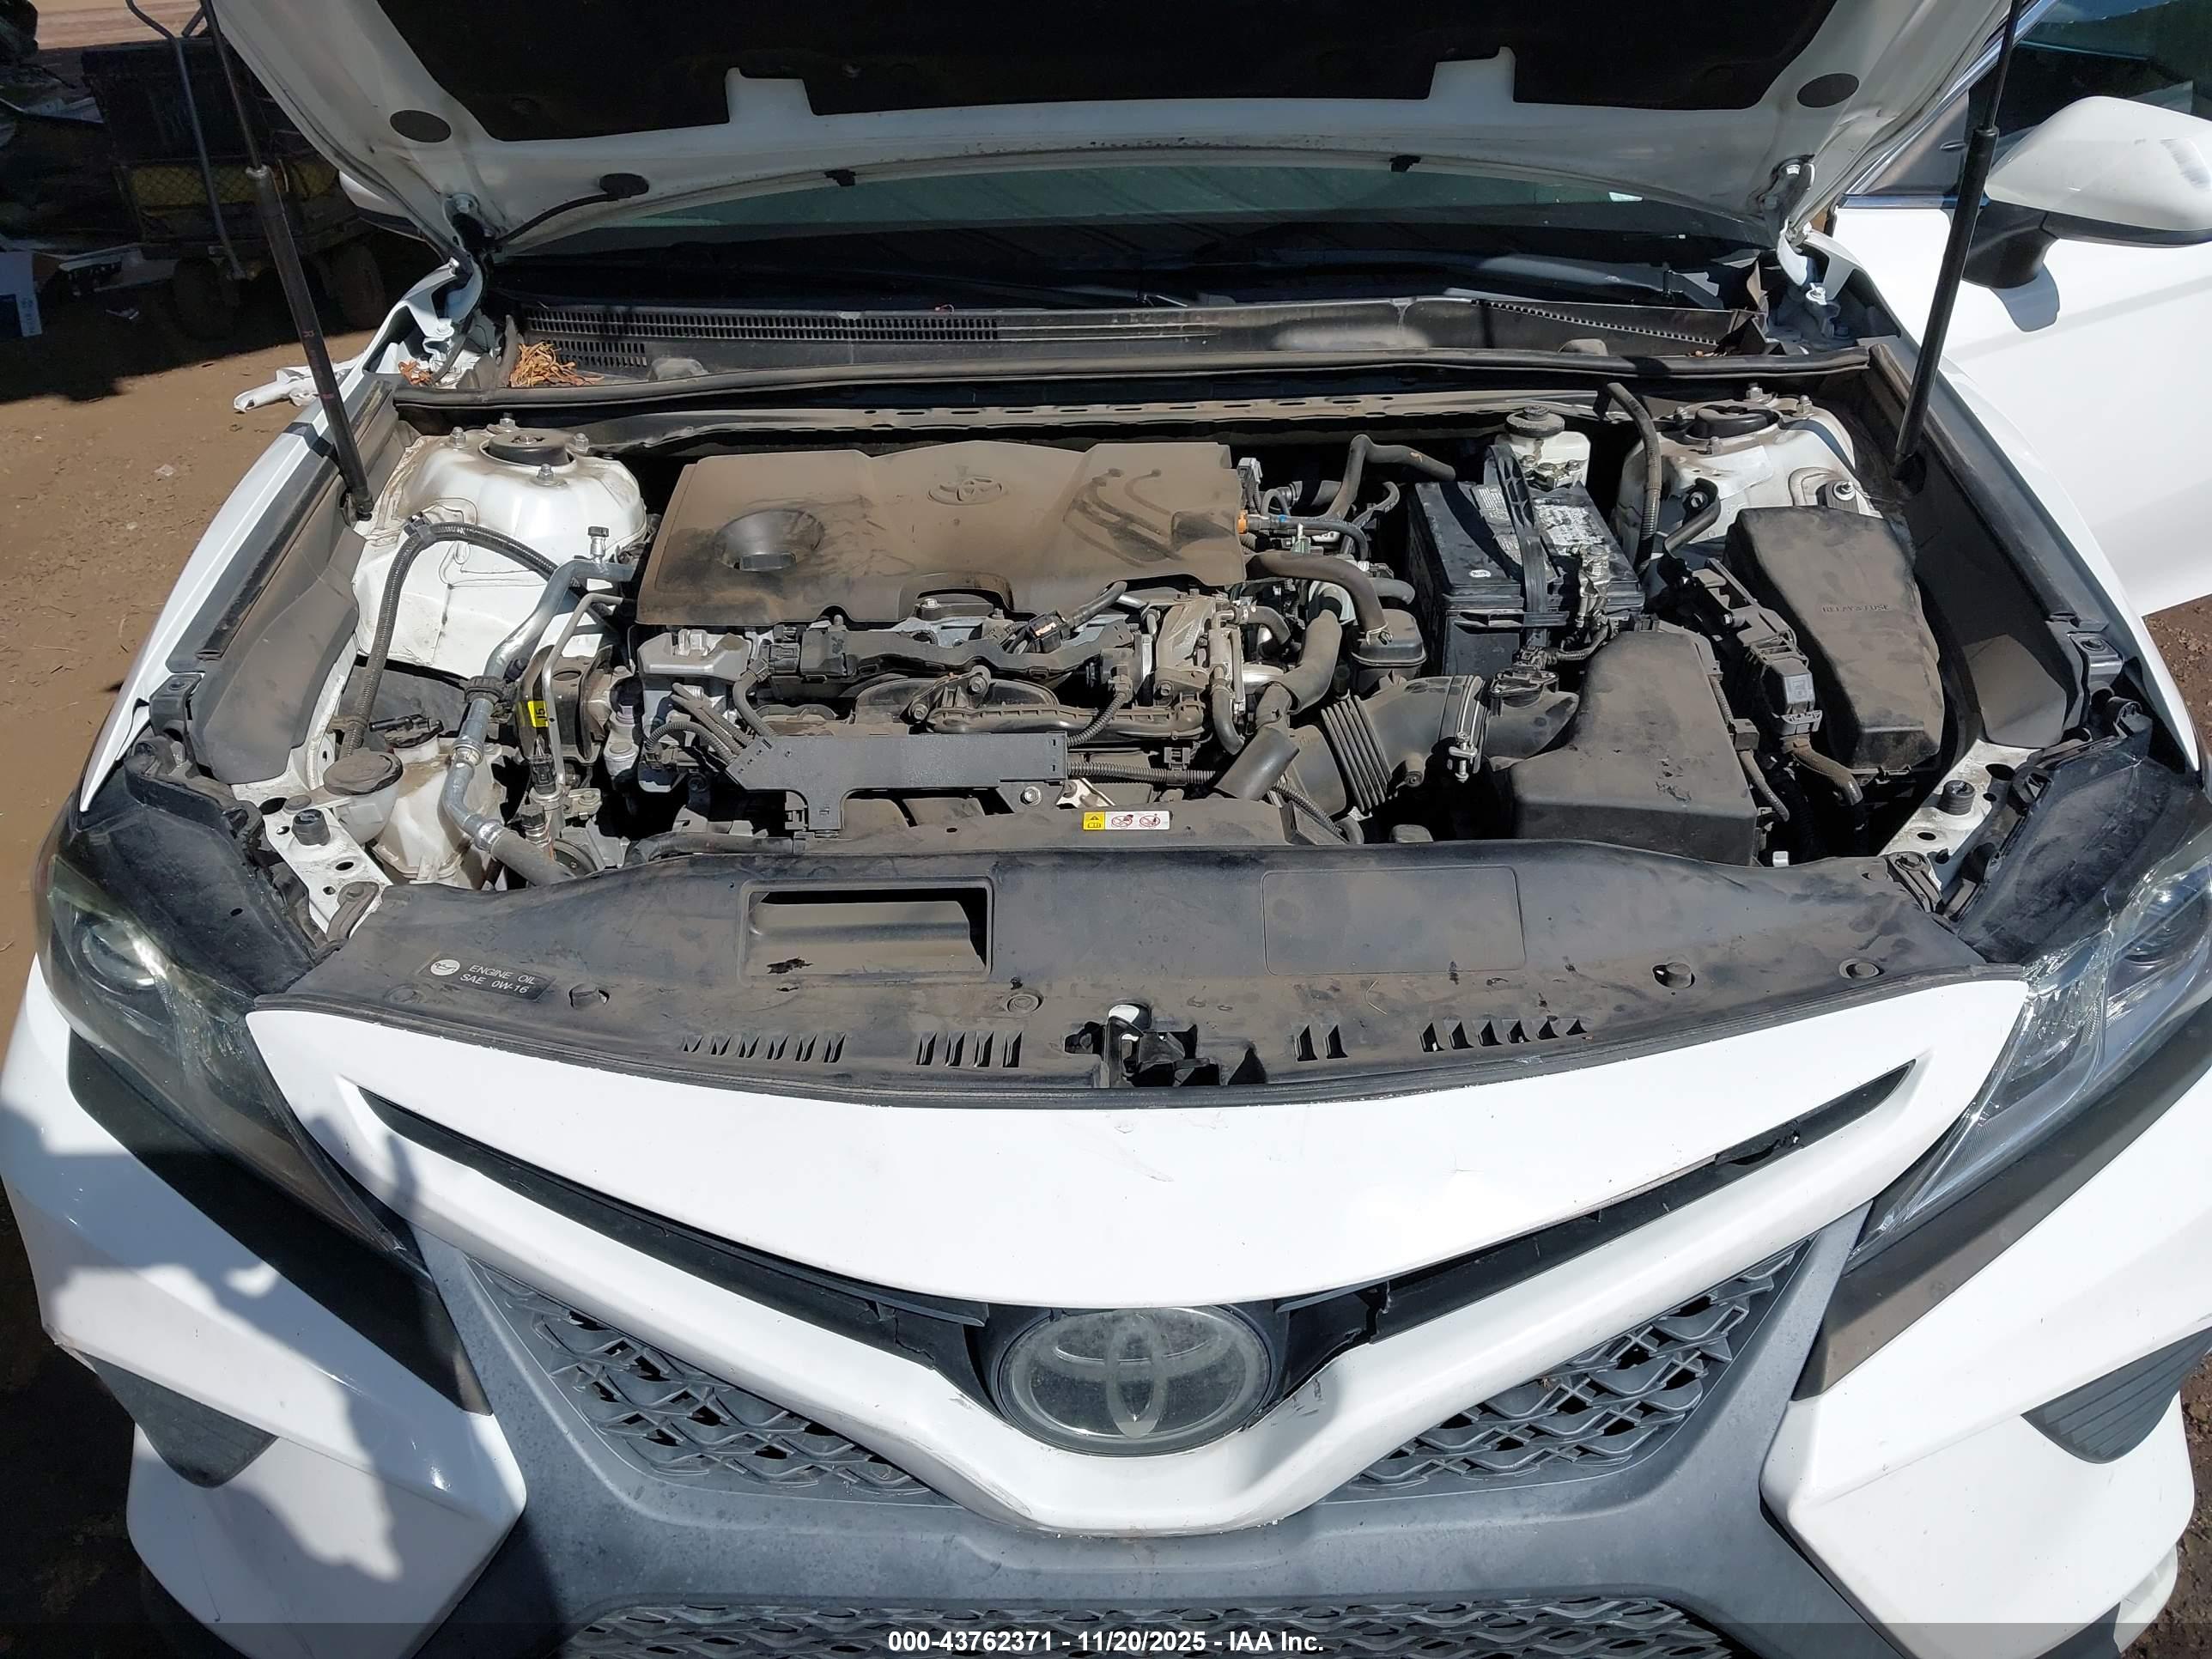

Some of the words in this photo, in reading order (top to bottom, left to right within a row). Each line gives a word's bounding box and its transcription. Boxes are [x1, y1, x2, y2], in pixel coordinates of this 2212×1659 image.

[459, 973, 486, 985] SAE
[491, 979, 530, 994] 0W-16
[469, 964, 514, 980] ENGINE
[517, 974, 536, 985] OIL
